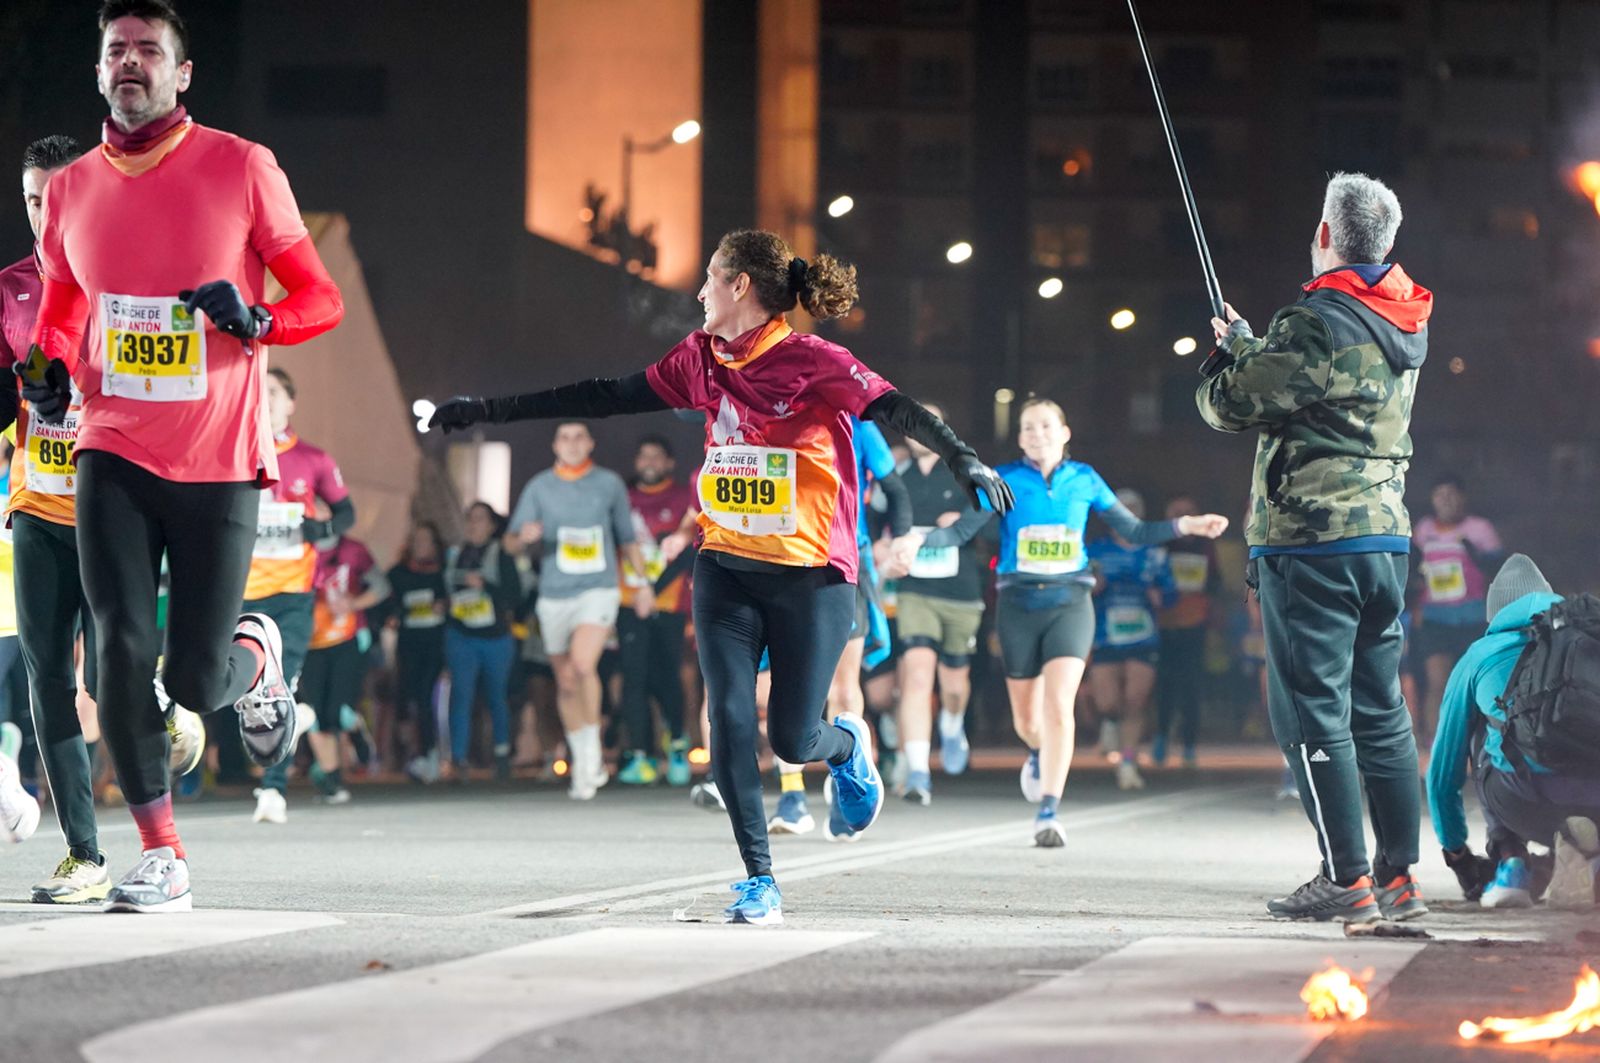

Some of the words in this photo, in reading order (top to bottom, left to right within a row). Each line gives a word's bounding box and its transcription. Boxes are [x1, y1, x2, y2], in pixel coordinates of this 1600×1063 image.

[121, 308, 146, 319] NCHE
[148, 309, 161, 319] DE
[112, 318, 127, 329] SA
[129, 320, 161, 333] ANTÓN
[115, 333, 190, 365] 13937
[747, 456, 758, 465] DE
[709, 465, 725, 475] SAN
[727, 465, 758, 476] ANTÓN
[716, 477, 775, 505] 8919
